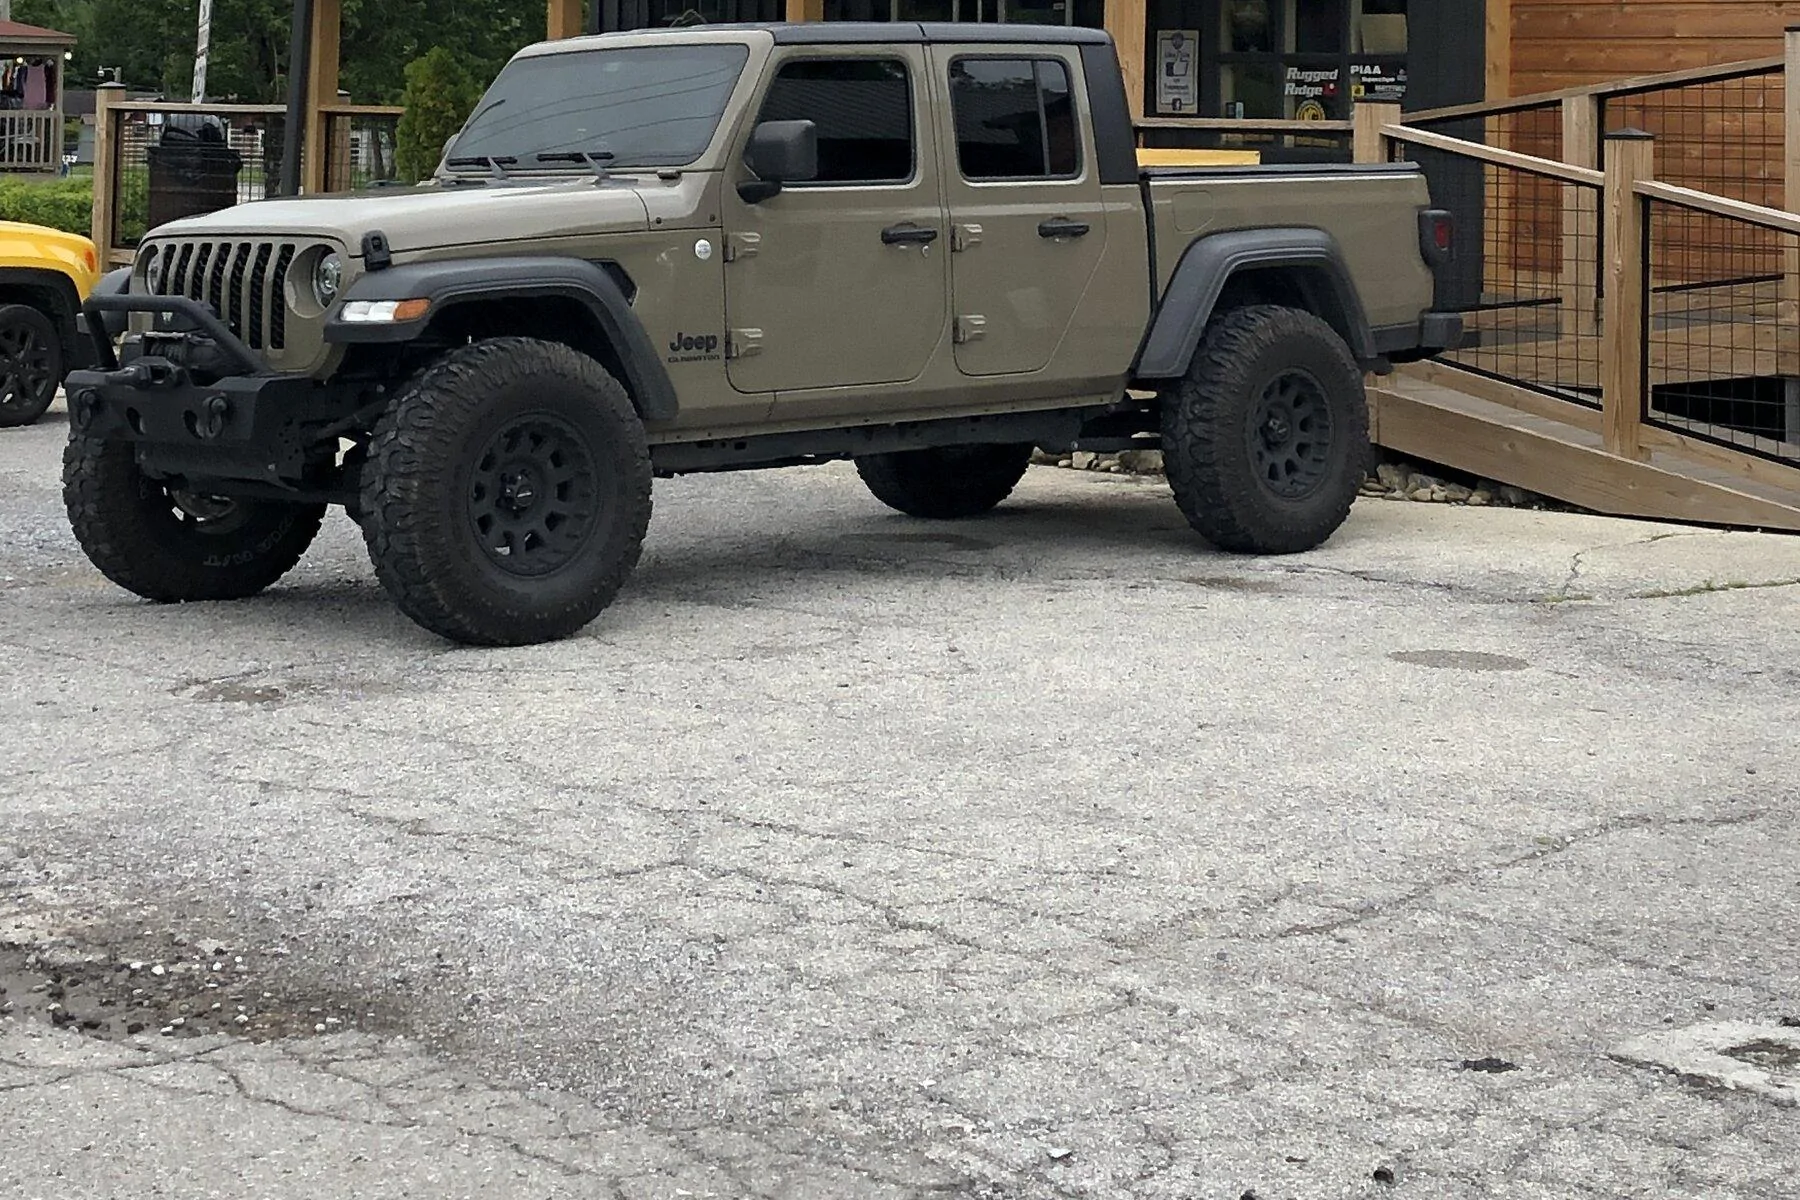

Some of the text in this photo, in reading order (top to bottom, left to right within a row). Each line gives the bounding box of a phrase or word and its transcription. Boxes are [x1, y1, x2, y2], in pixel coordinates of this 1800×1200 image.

[1286, 67, 1338, 82] Rugged
[1284, 82, 1323, 98] Ridge
[669, 332, 718, 353] Jeep
